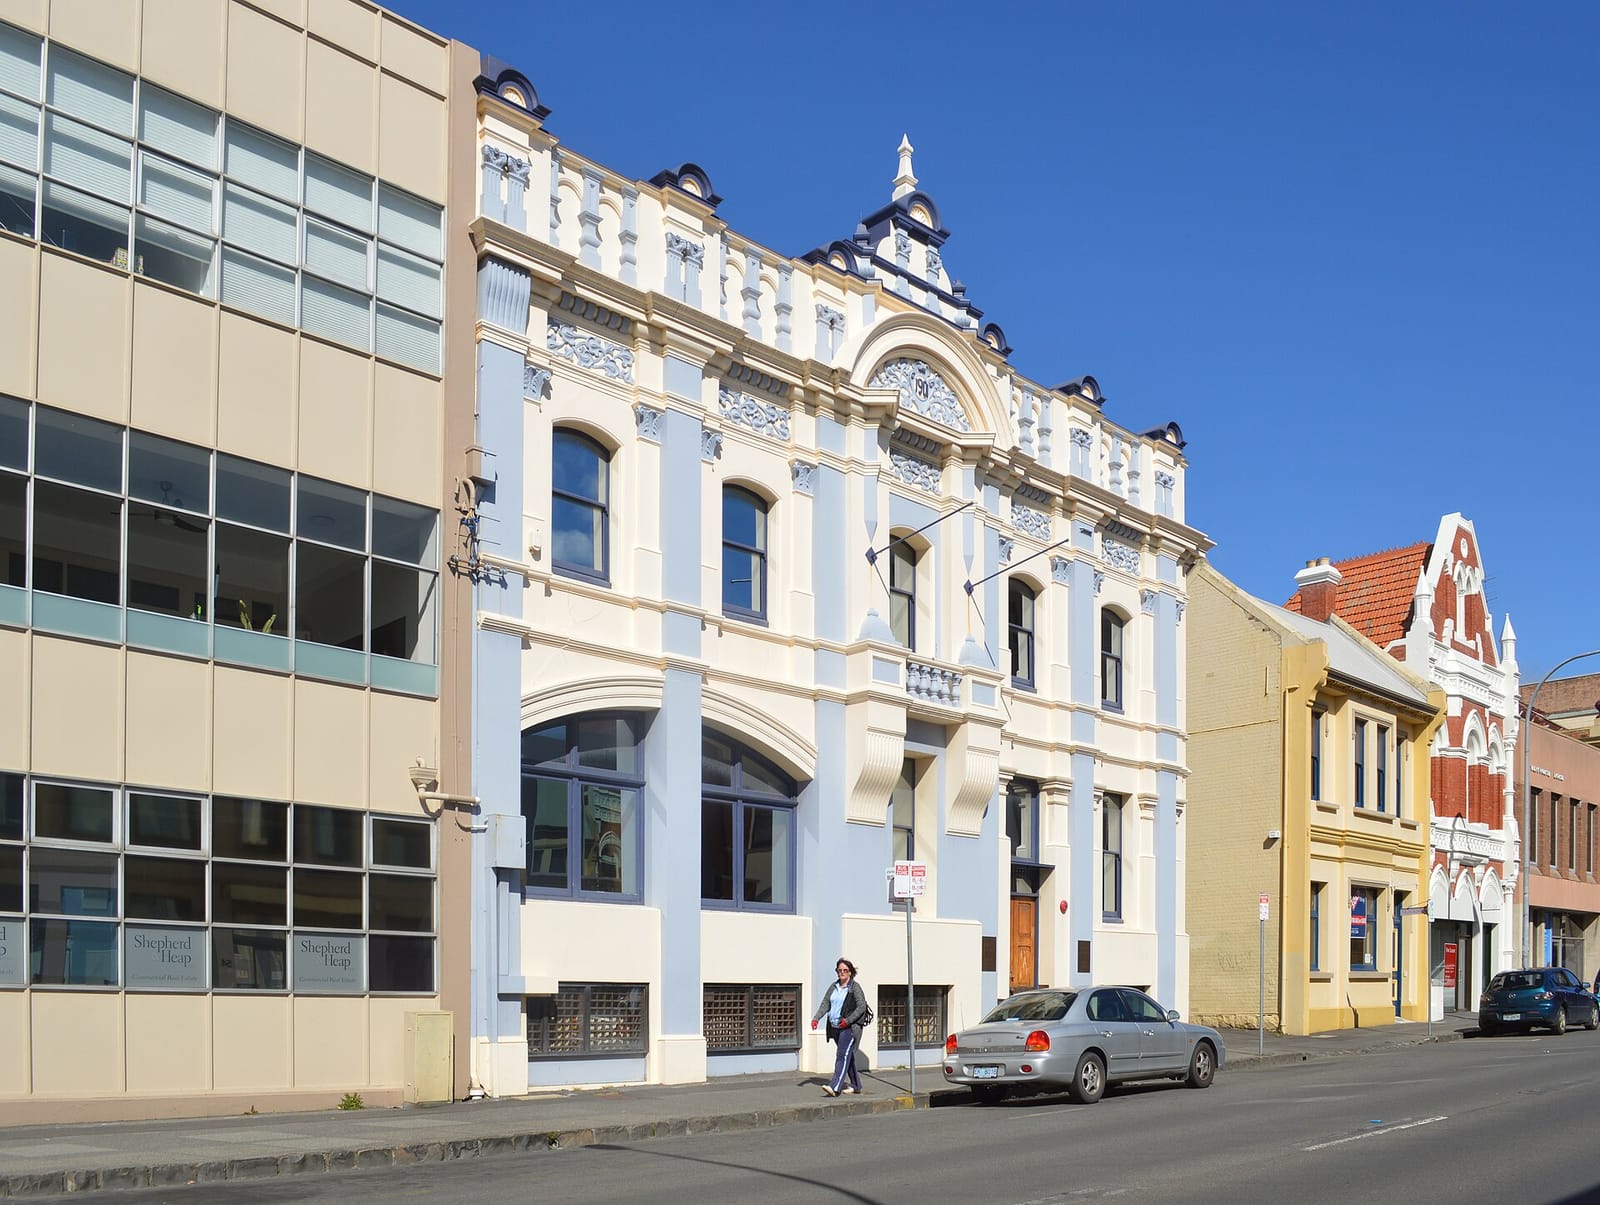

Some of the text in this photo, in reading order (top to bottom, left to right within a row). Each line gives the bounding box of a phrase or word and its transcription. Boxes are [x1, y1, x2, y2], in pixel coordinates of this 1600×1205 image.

[134, 935, 191, 952] Shepherd
[301, 940, 351, 957] Shepherd
[161, 950, 192, 967] Heap
[325, 954, 351, 971] Heap
